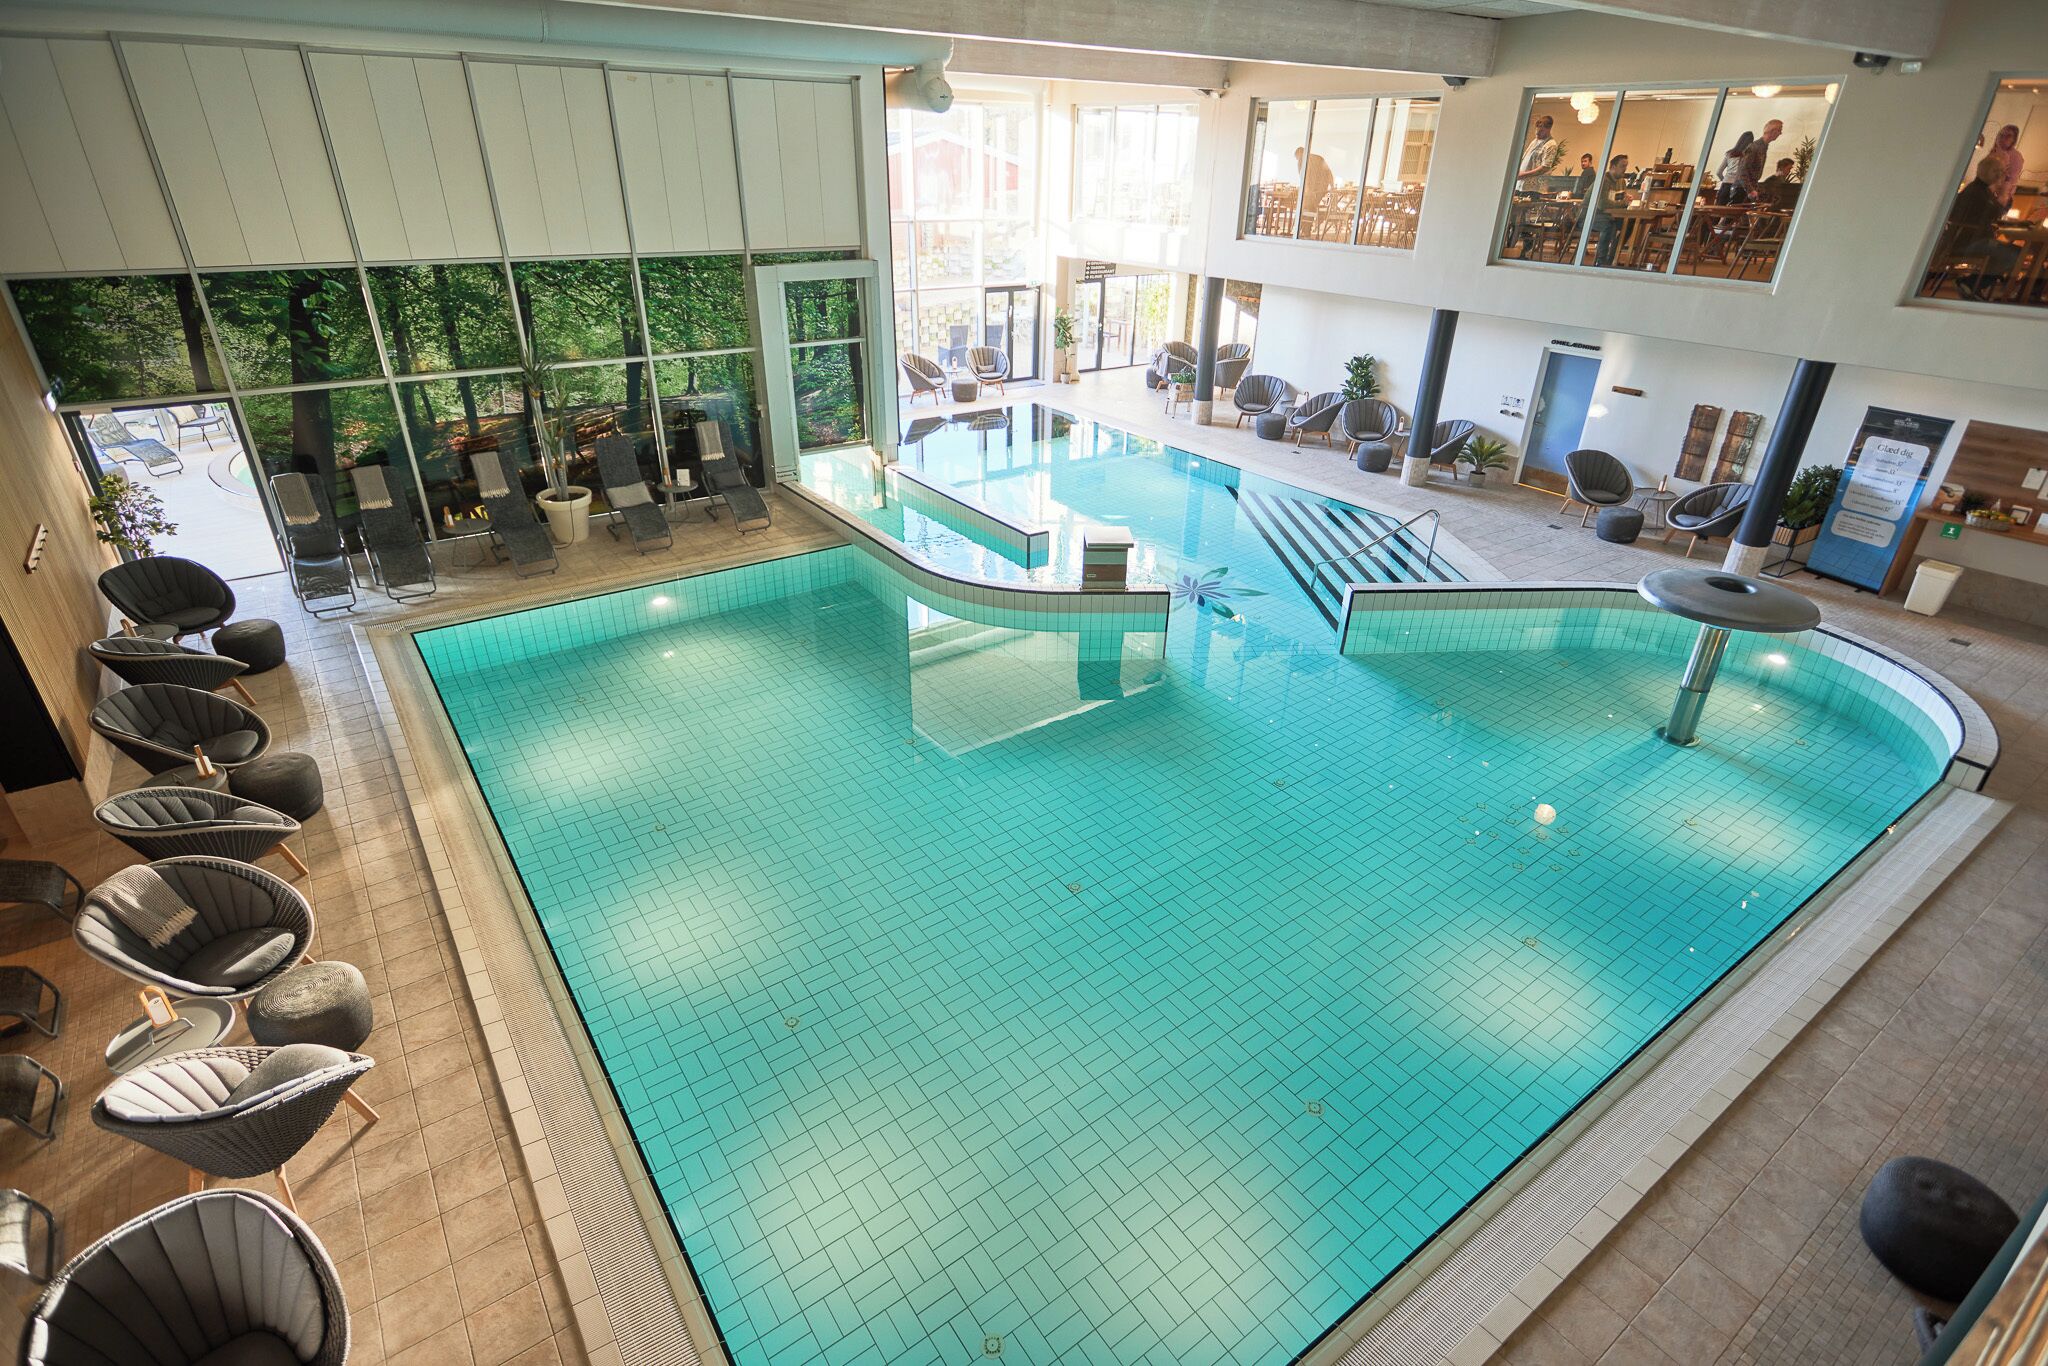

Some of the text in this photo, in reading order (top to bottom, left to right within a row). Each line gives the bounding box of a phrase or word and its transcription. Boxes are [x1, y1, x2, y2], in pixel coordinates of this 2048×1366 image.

[1551, 339, 1601, 351] OMKLÆDNING
[1877, 443, 1914, 459] Glæd dig
